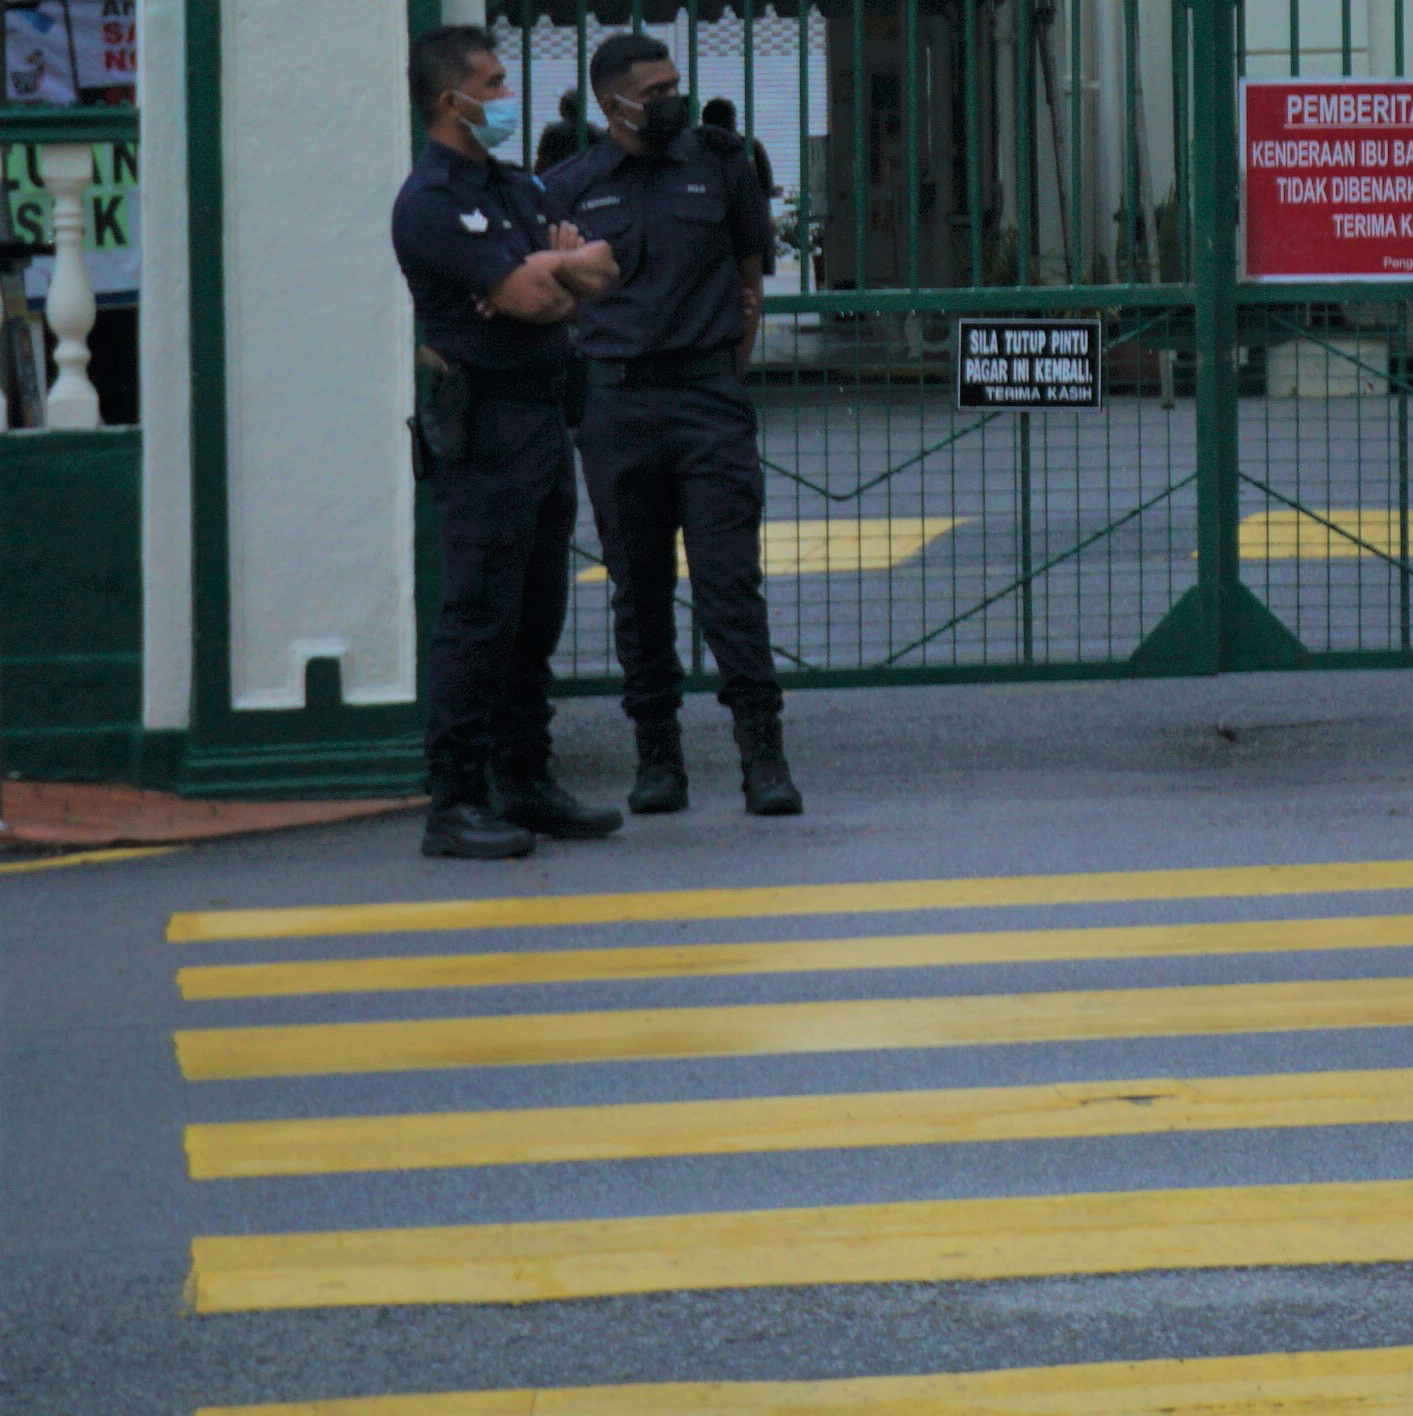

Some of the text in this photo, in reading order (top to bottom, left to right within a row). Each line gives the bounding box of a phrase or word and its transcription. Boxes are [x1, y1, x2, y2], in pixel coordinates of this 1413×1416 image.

[1252, 141, 1356, 168] KENDERAAN
[1361, 140, 1389, 167] IBU
[1276, 177, 1328, 204] TIDAK
[1333, 213, 1397, 238] TERIMA
[970, 329, 1089, 355] SILA TUTUP PINTU
[966, 358, 1008, 383] PAGAR
[1013, 358, 1030, 383] INI
[985, 386, 1092, 401] TERIMA KASIH
